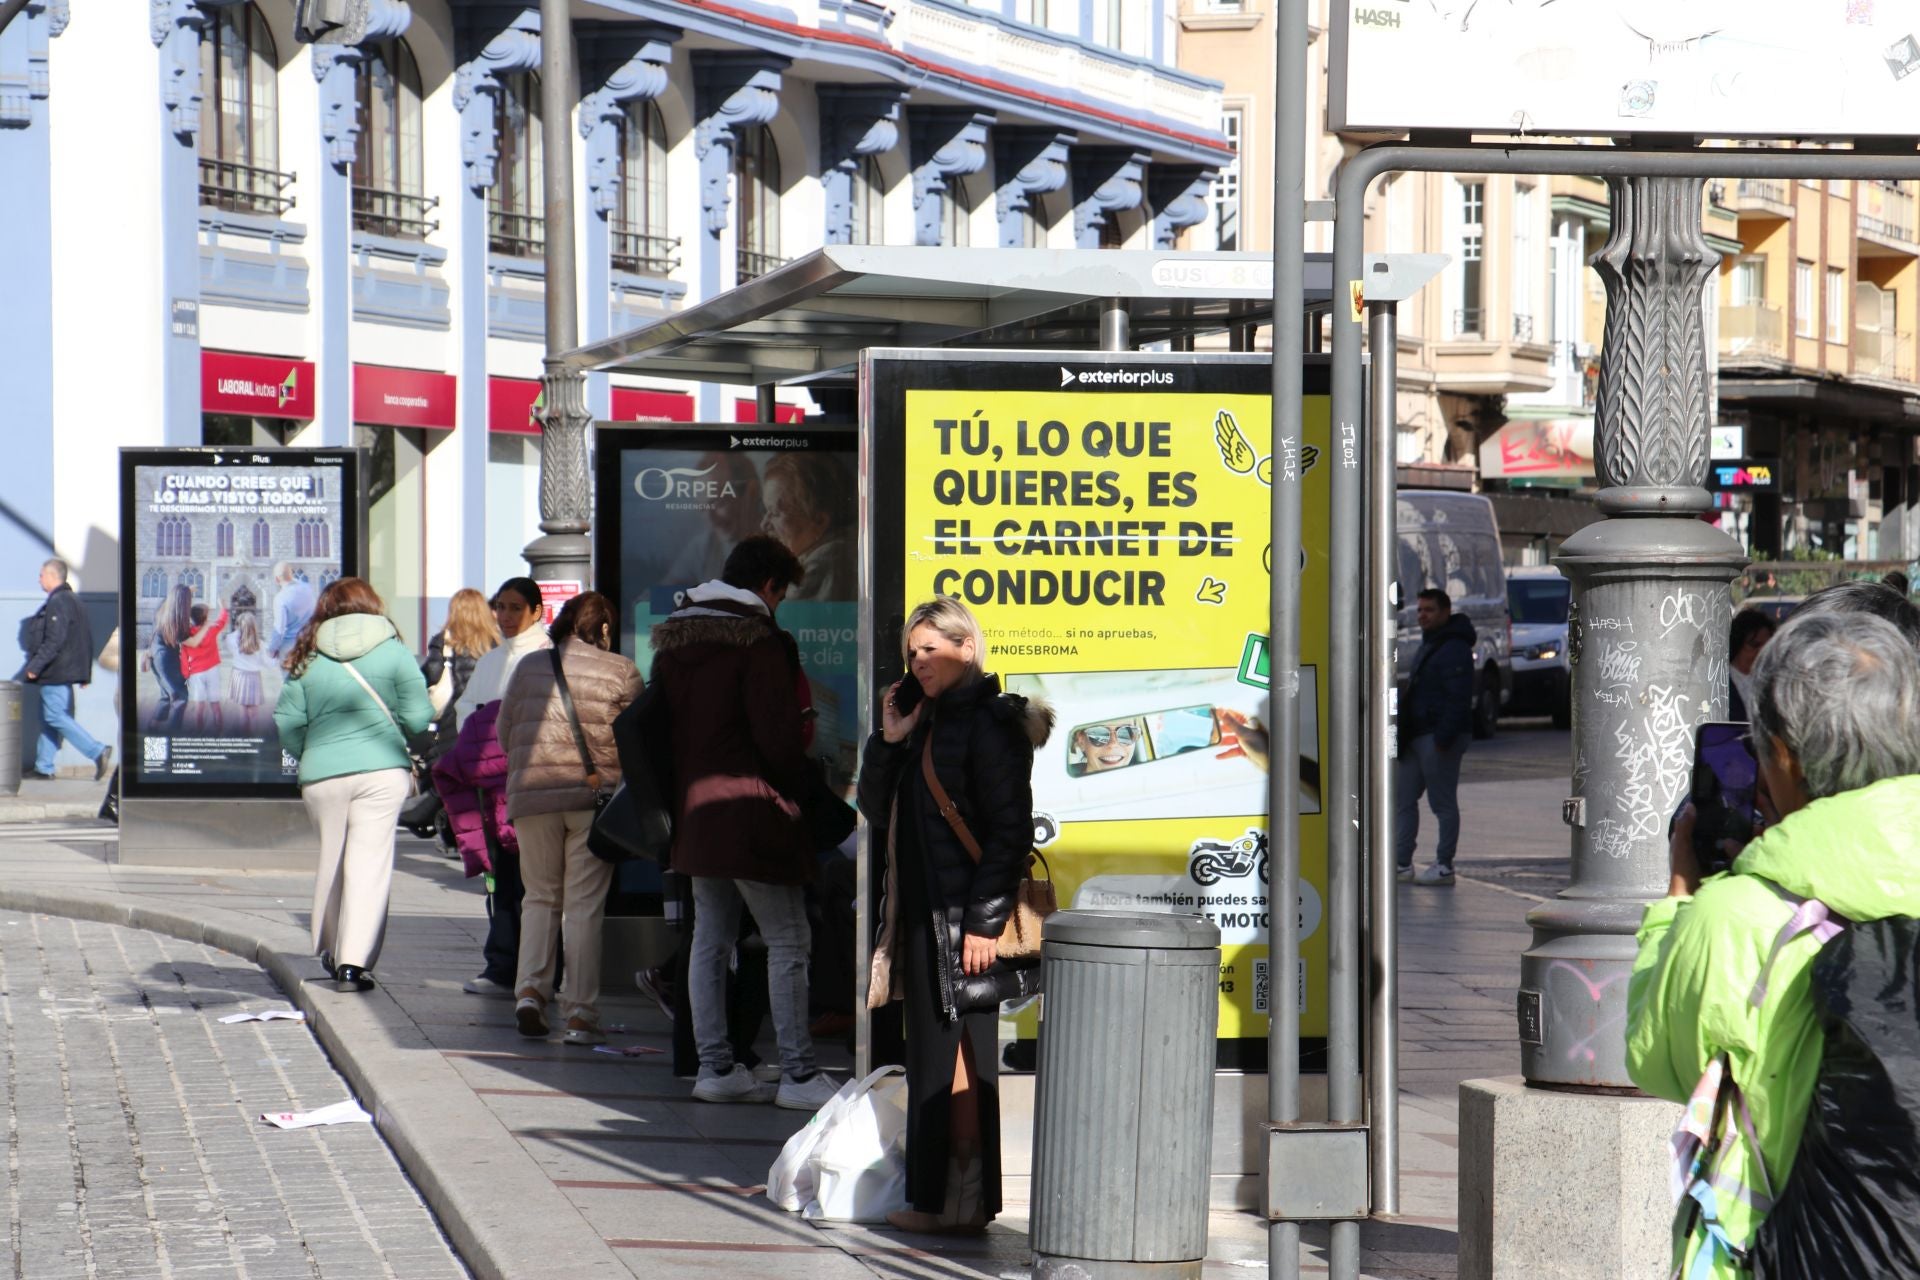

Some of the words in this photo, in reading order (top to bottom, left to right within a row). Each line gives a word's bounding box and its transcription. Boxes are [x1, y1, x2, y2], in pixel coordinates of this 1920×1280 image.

[1355, 8, 1401, 29] HASH
[1078, 369, 1174, 386] exteriorplus
[218, 378, 255, 396] LABORAL
[742, 436, 809, 448] exteriorplus
[933, 410, 1003, 462] TÚ,
[1017, 420, 1070, 457] LO
[1082, 420, 1172, 459] QUE
[166, 475, 229, 489] CUANDO
[231, 475, 277, 490] CREES
[280, 475, 310, 491] QUE
[634, 462, 736, 500] ORPEA
[154, 490, 176, 504] LO
[179, 491, 209, 504] HAS
[213, 491, 259, 504] VISTO
[933, 469, 1134, 513] QUIERES,
[1148, 471, 1198, 507] ES
[149, 504, 159, 513] TE
[160, 505, 217, 513] DESCUBRIMOS
[218, 505, 228, 513] TU
[229, 505, 257, 514] NUEVO
[258, 506, 285, 514] LUGAR
[287, 506, 328, 514] FAVORITO
[934, 519, 981, 556] EL
[993, 520, 1165, 557] CARNET
[1178, 521, 1234, 557] DE
[933, 569, 1166, 607] CONDUCIR
[982, 628, 1004, 638] stro
[1065, 628, 1076, 638] si
[1079, 630, 1094, 638] no
[1097, 628, 1157, 640] apruebas,
[814, 647, 843, 665] día
[991, 645, 1079, 655] #NOESBROMA
[1090, 893, 1134, 905] Ahora
[1136, 893, 1194, 905] también
[1197, 893, 1248, 908] puedes
